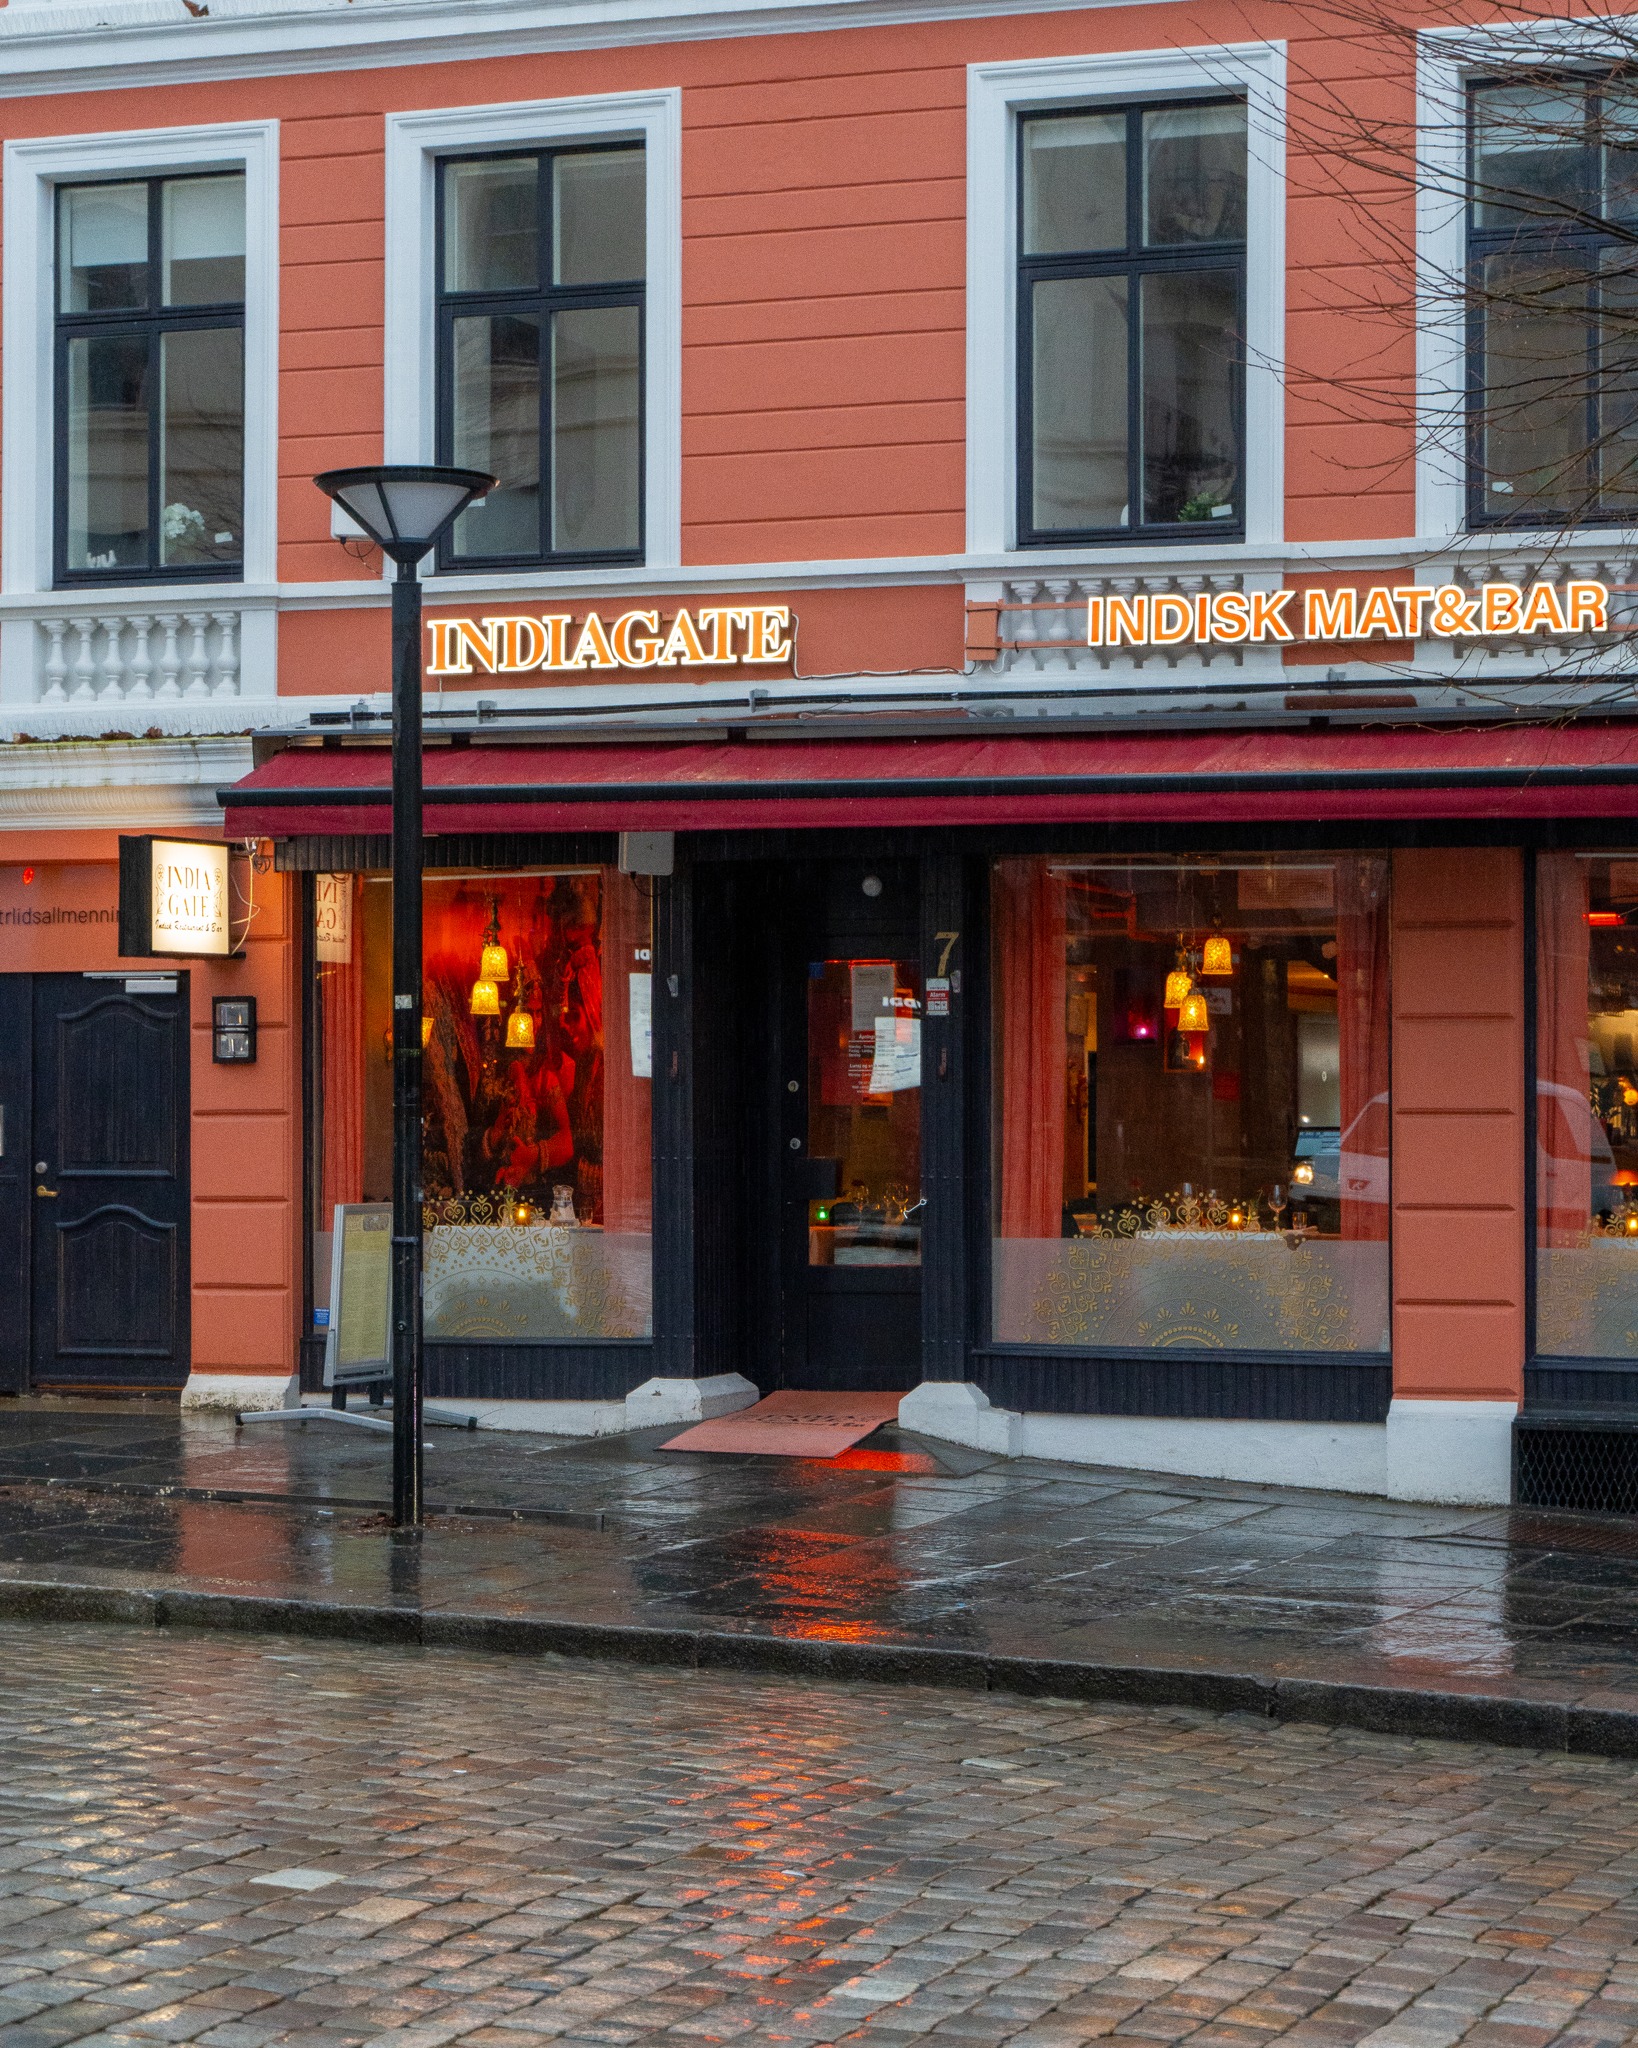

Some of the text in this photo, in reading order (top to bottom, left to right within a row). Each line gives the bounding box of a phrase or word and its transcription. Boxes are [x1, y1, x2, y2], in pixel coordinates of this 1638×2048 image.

[1088, 580, 1609, 647] INDISK MAT&BAR
[167, 865, 211, 891] INDIA
[168, 893, 210, 917] GATE
[934, 931, 960, 977] 7
